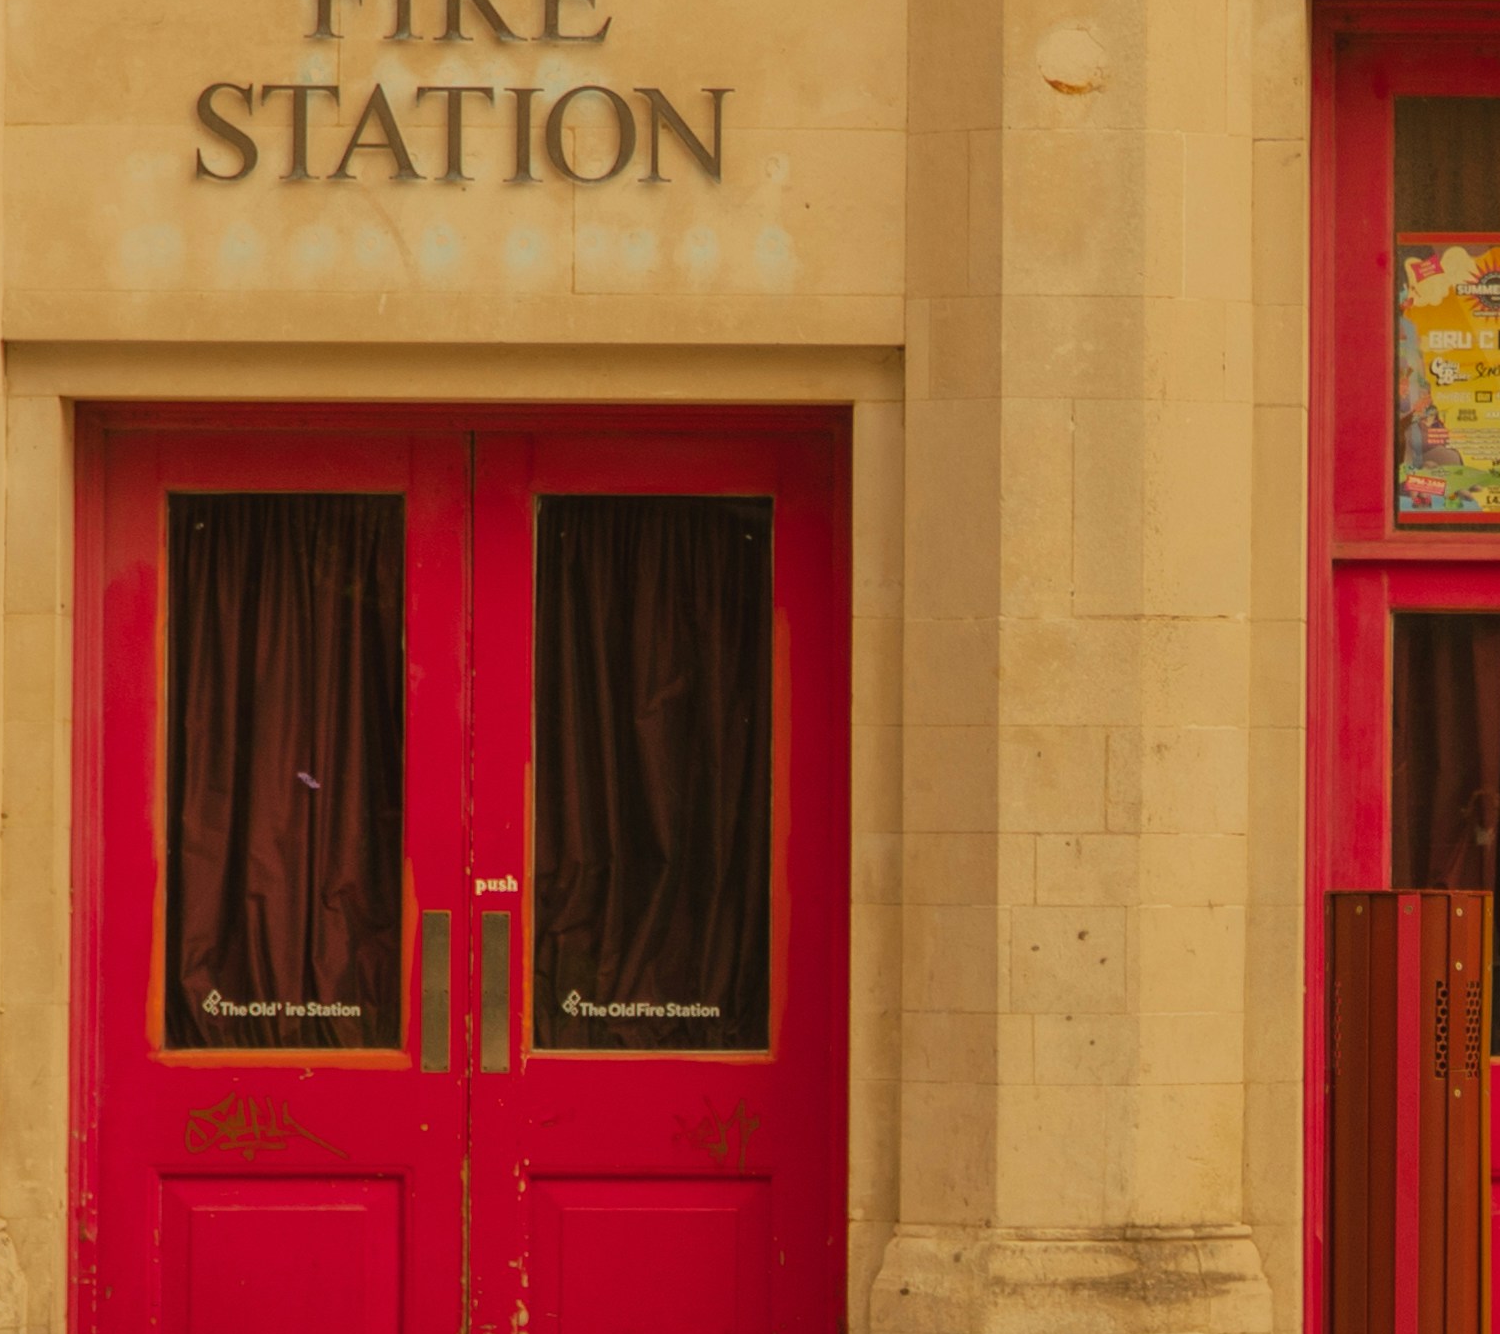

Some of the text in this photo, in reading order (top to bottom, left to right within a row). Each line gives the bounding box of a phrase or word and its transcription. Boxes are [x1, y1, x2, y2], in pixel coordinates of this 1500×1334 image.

[195, 82, 734, 185] STATION
[1429, 330, 1472, 350] BRU
[1479, 330, 1494, 350] C
[475, 874, 518, 896] push
[220, 1002, 361, 1016] The Old ire Station
[580, 1003, 720, 1017] The Old Fire Station
